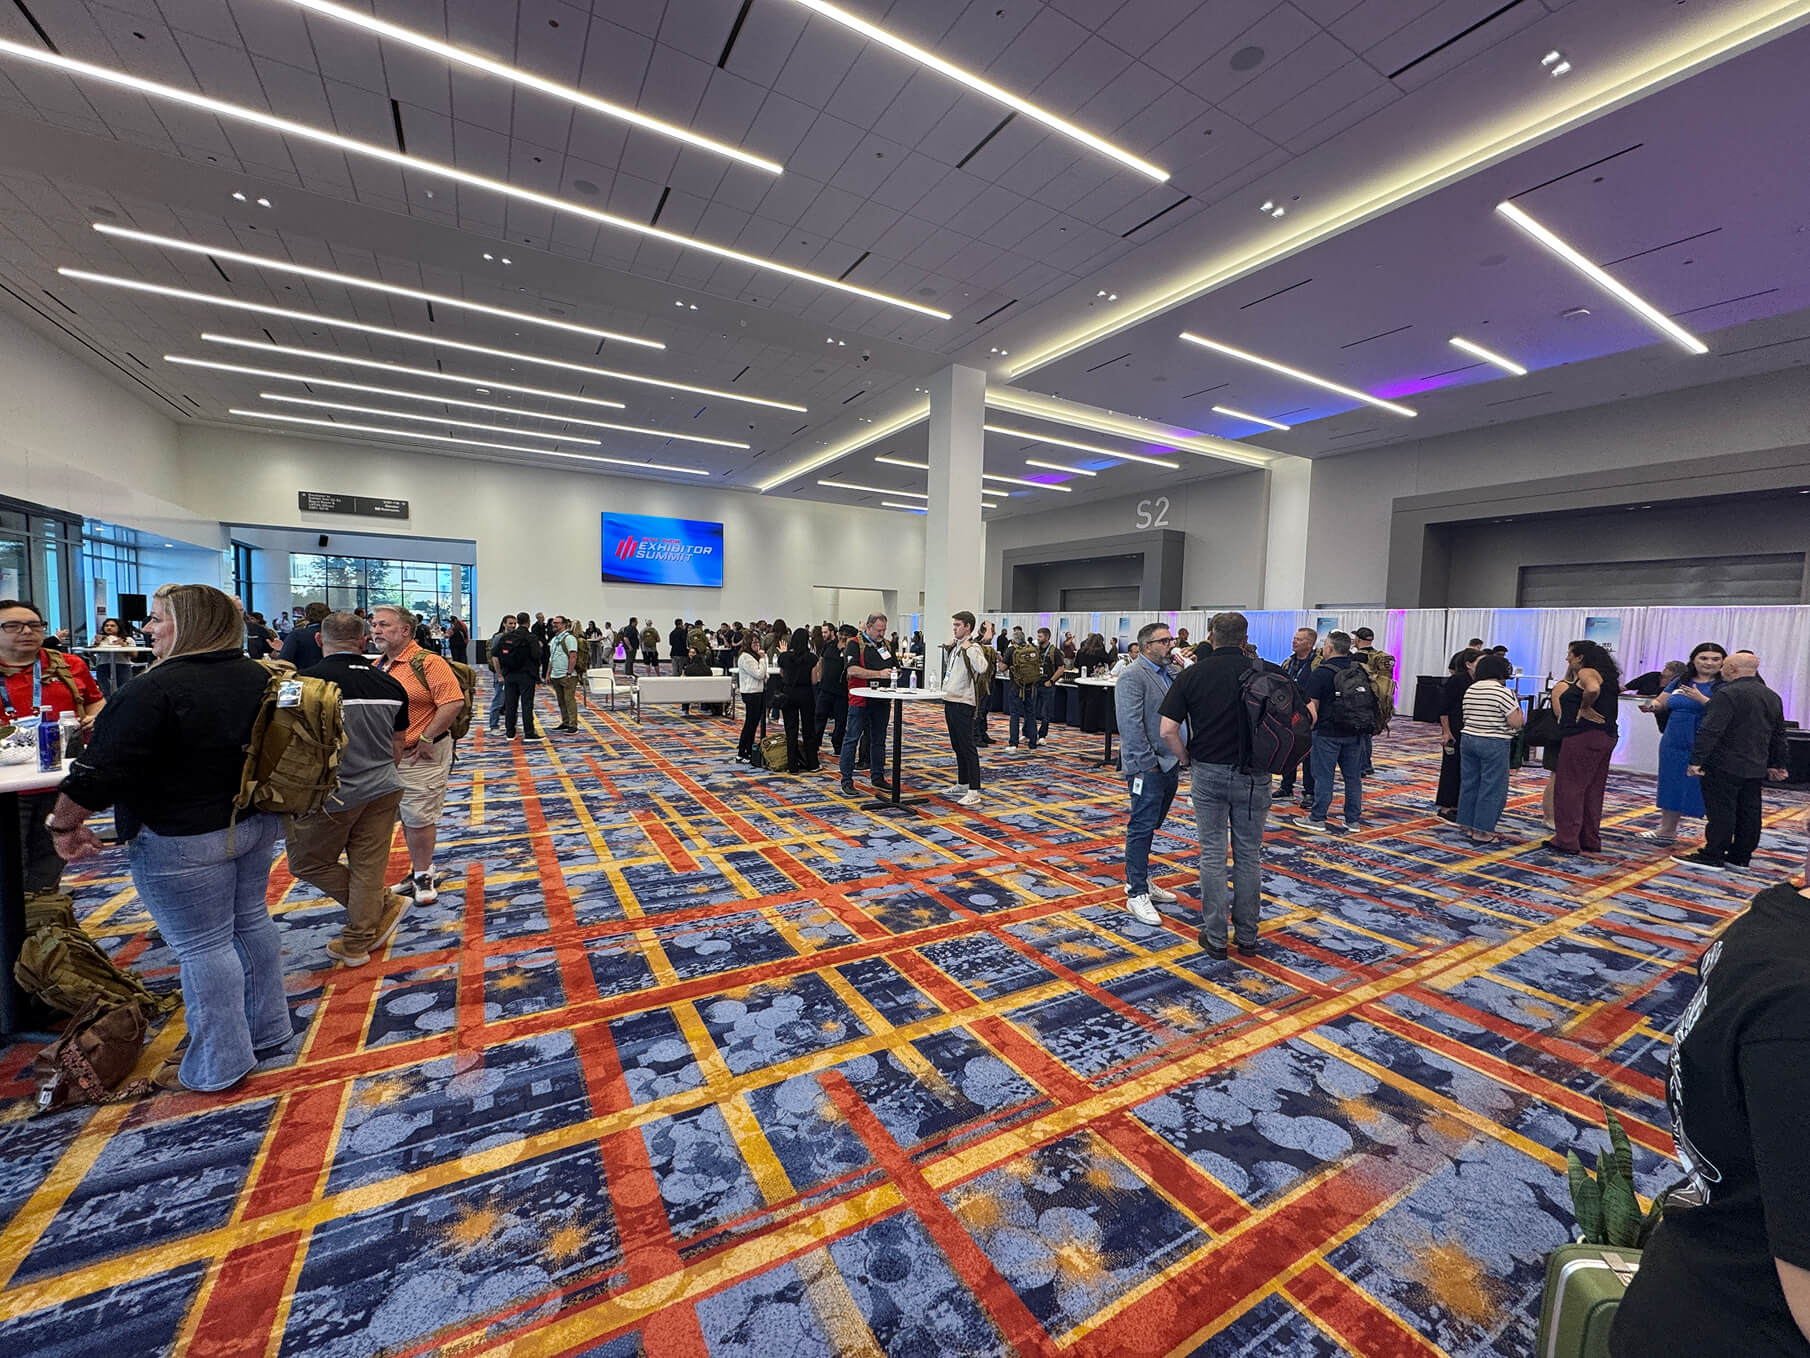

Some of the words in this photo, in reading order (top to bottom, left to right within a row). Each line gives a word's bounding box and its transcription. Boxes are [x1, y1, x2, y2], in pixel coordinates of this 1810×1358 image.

[1135, 496, 1170, 529] S2
[638, 541, 713, 555] EXHIBITOR
[635, 550, 694, 562] SUMMIT
